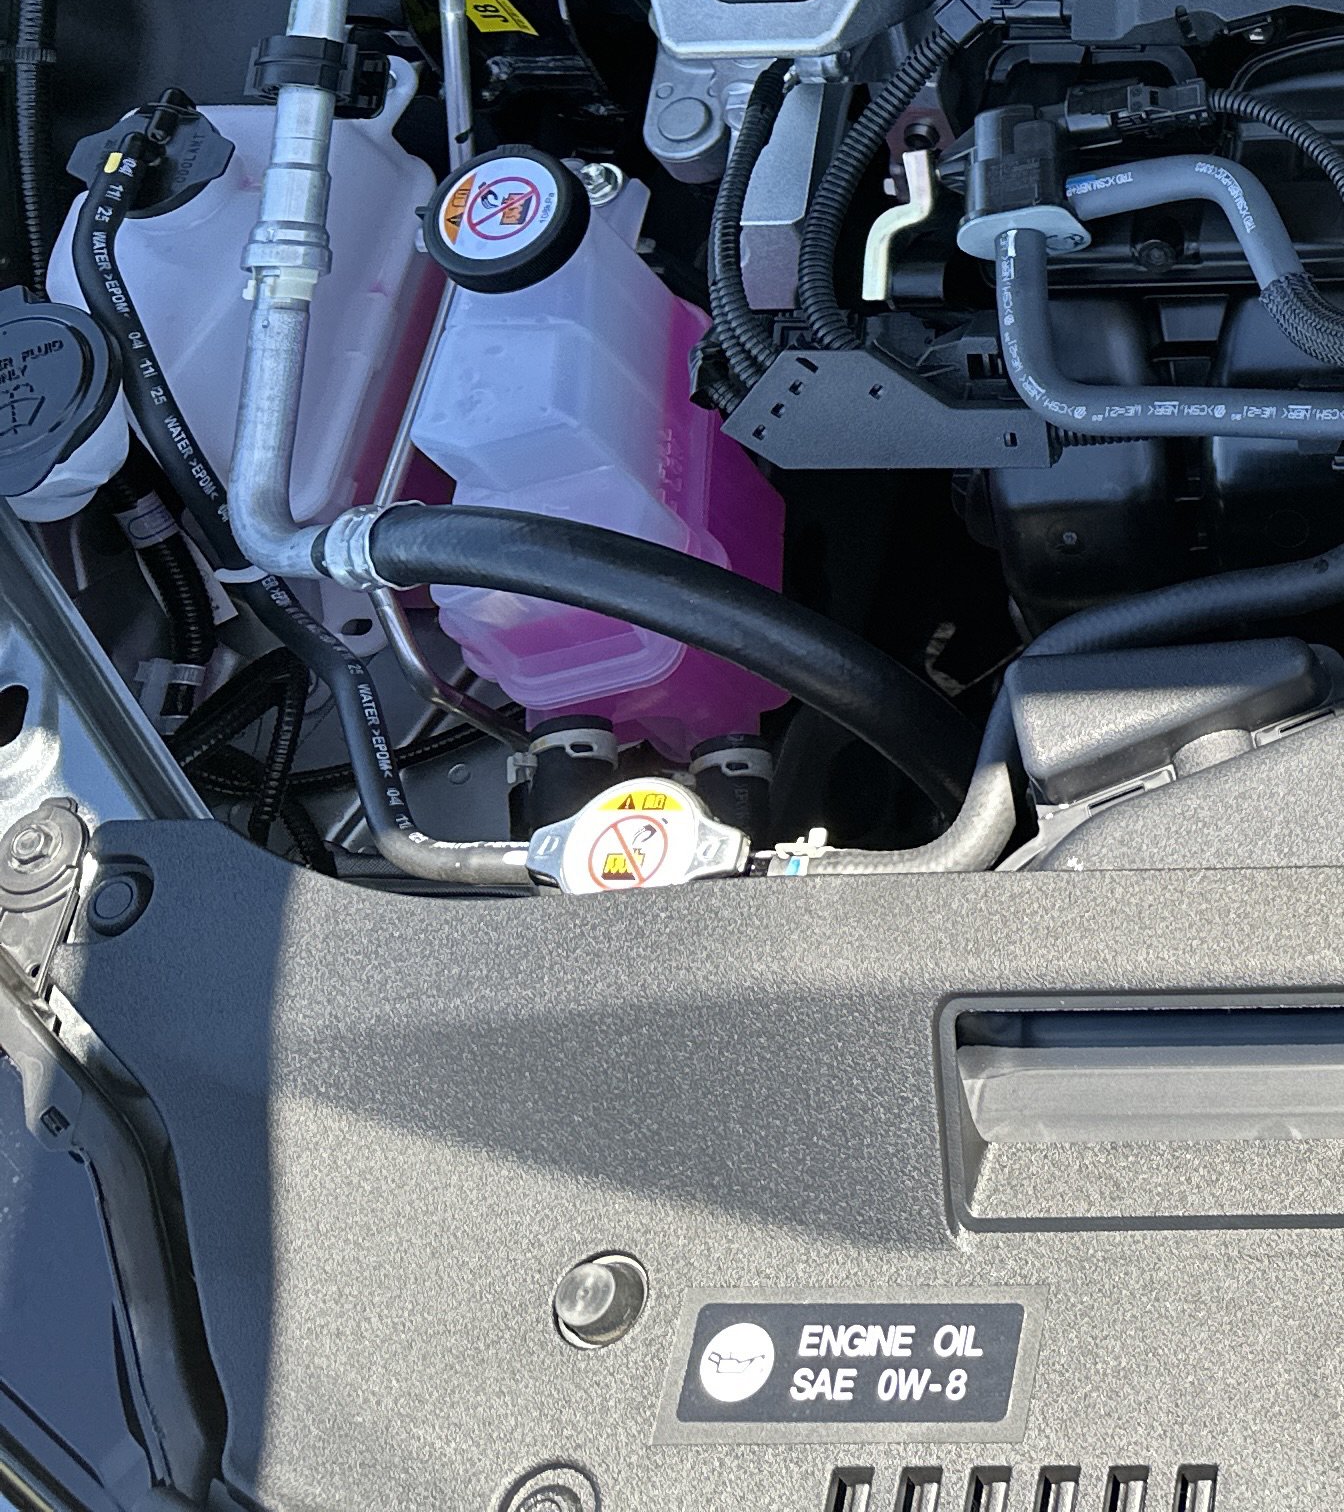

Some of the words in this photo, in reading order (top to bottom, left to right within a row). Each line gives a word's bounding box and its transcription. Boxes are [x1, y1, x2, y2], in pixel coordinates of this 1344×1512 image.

[473, 3, 510, 23] J8
[176, 134, 206, 184] COOLANT
[1116, 171, 1134, 185] TRD
[1243, 215, 1257, 234] TRD
[92, 231, 112, 271] WATER
[164, 415, 195, 460] WATER
[357, 683, 381, 726] WATER
[798, 1324, 916, 1357] ENGINE
[934, 1324, 984, 1358] OIL
[790, 1368, 857, 1401] SAE
[878, 1368, 967, 1401] 0W-8
